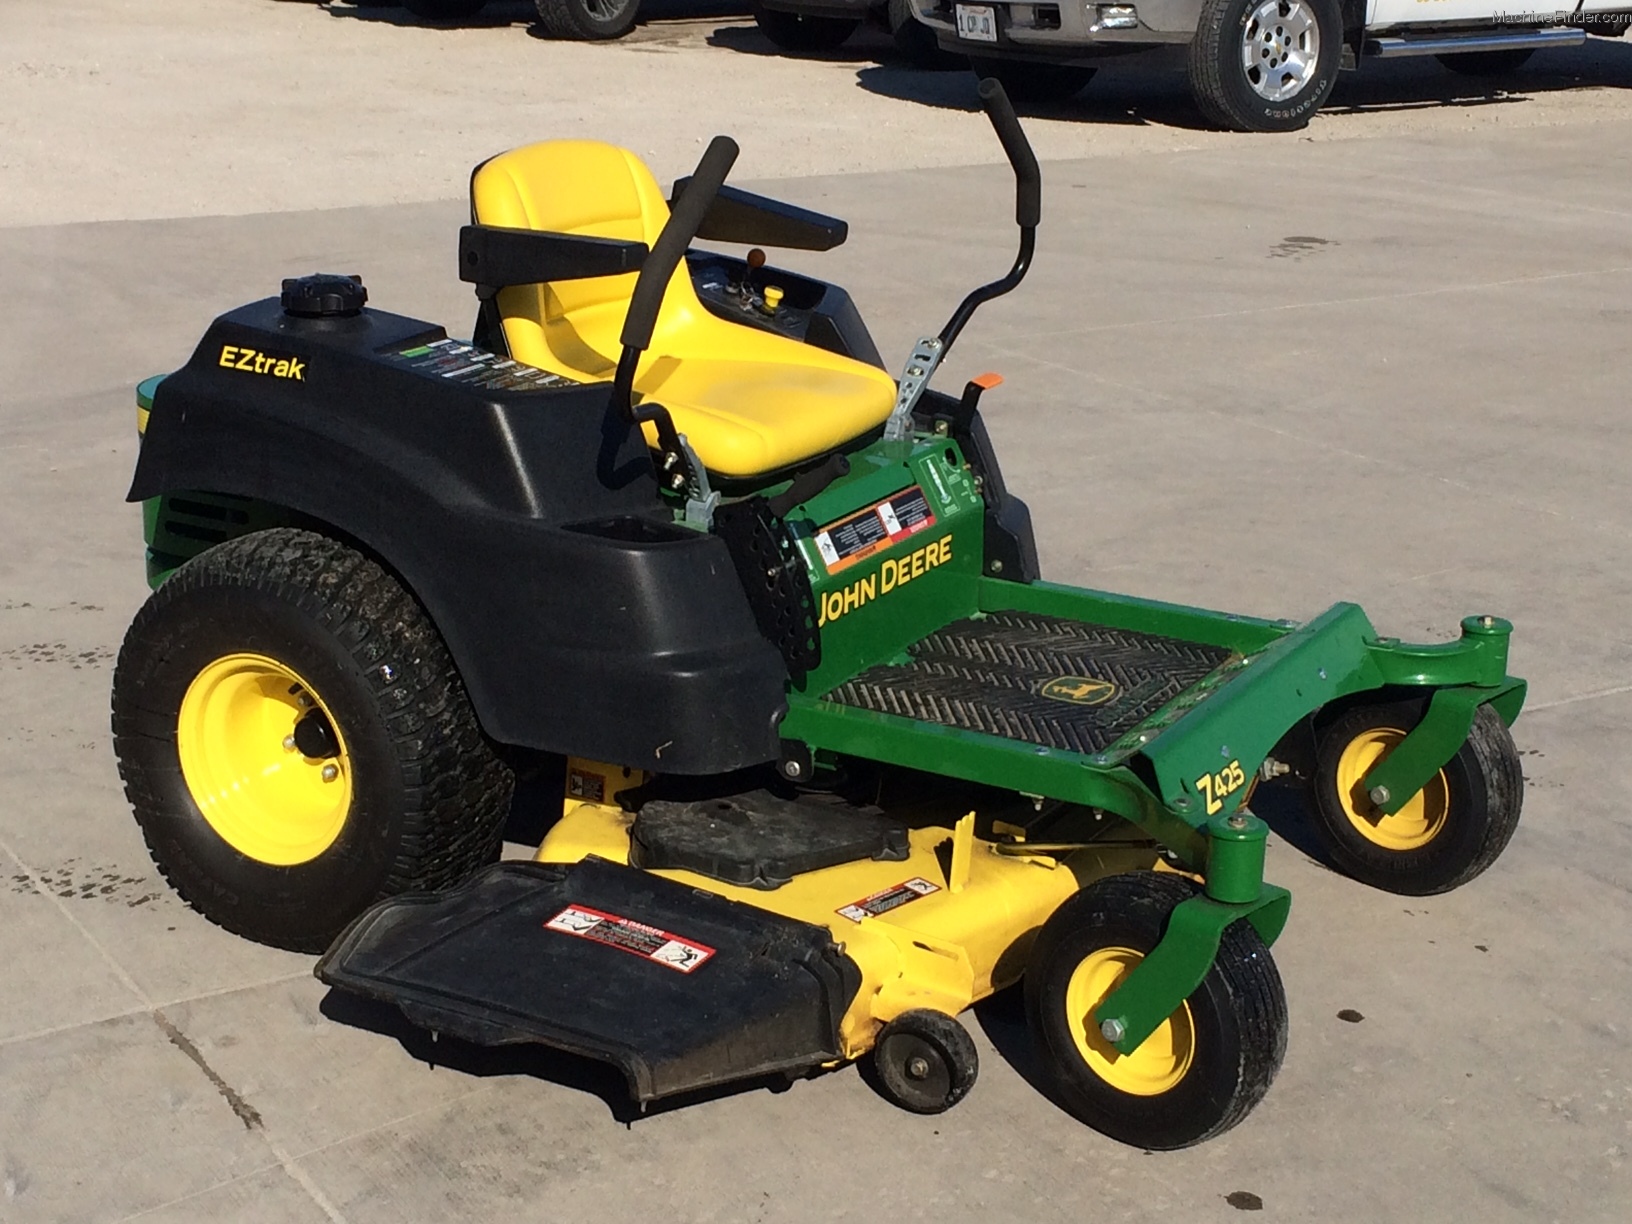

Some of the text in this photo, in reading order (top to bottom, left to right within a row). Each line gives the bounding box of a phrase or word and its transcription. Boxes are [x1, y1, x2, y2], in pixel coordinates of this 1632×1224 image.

[219, 345, 305, 380] EZtrak
[818, 534, 953, 628] JOHN DEERE
[1195, 759, 1245, 816] Z425
